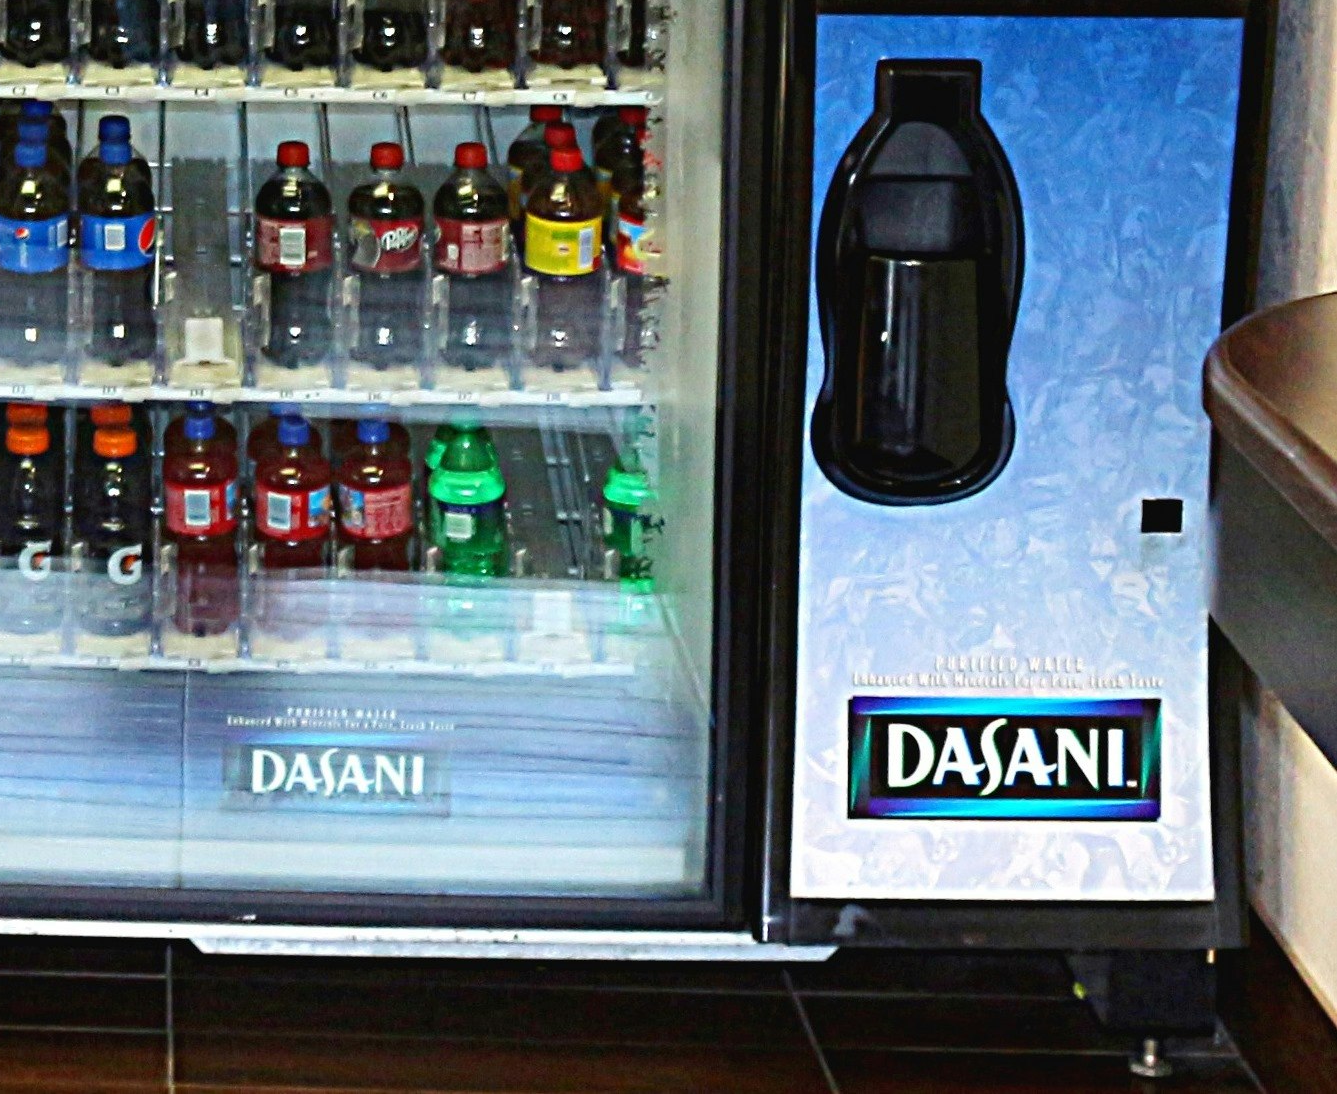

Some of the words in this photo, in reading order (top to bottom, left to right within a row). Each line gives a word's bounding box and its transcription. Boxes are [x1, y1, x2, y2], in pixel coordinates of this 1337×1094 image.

[107, 542, 143, 585] G
[852, 673, 913, 687] Enhanced
[915, 673, 948, 687] With
[952, 673, 1008, 687] Minerals
[934, 656, 1017, 671] PURIFIED
[1026, 657, 1085, 672] WATER
[251, 748, 425, 796] DASANI
[887, 717, 1125, 797] DASANI
